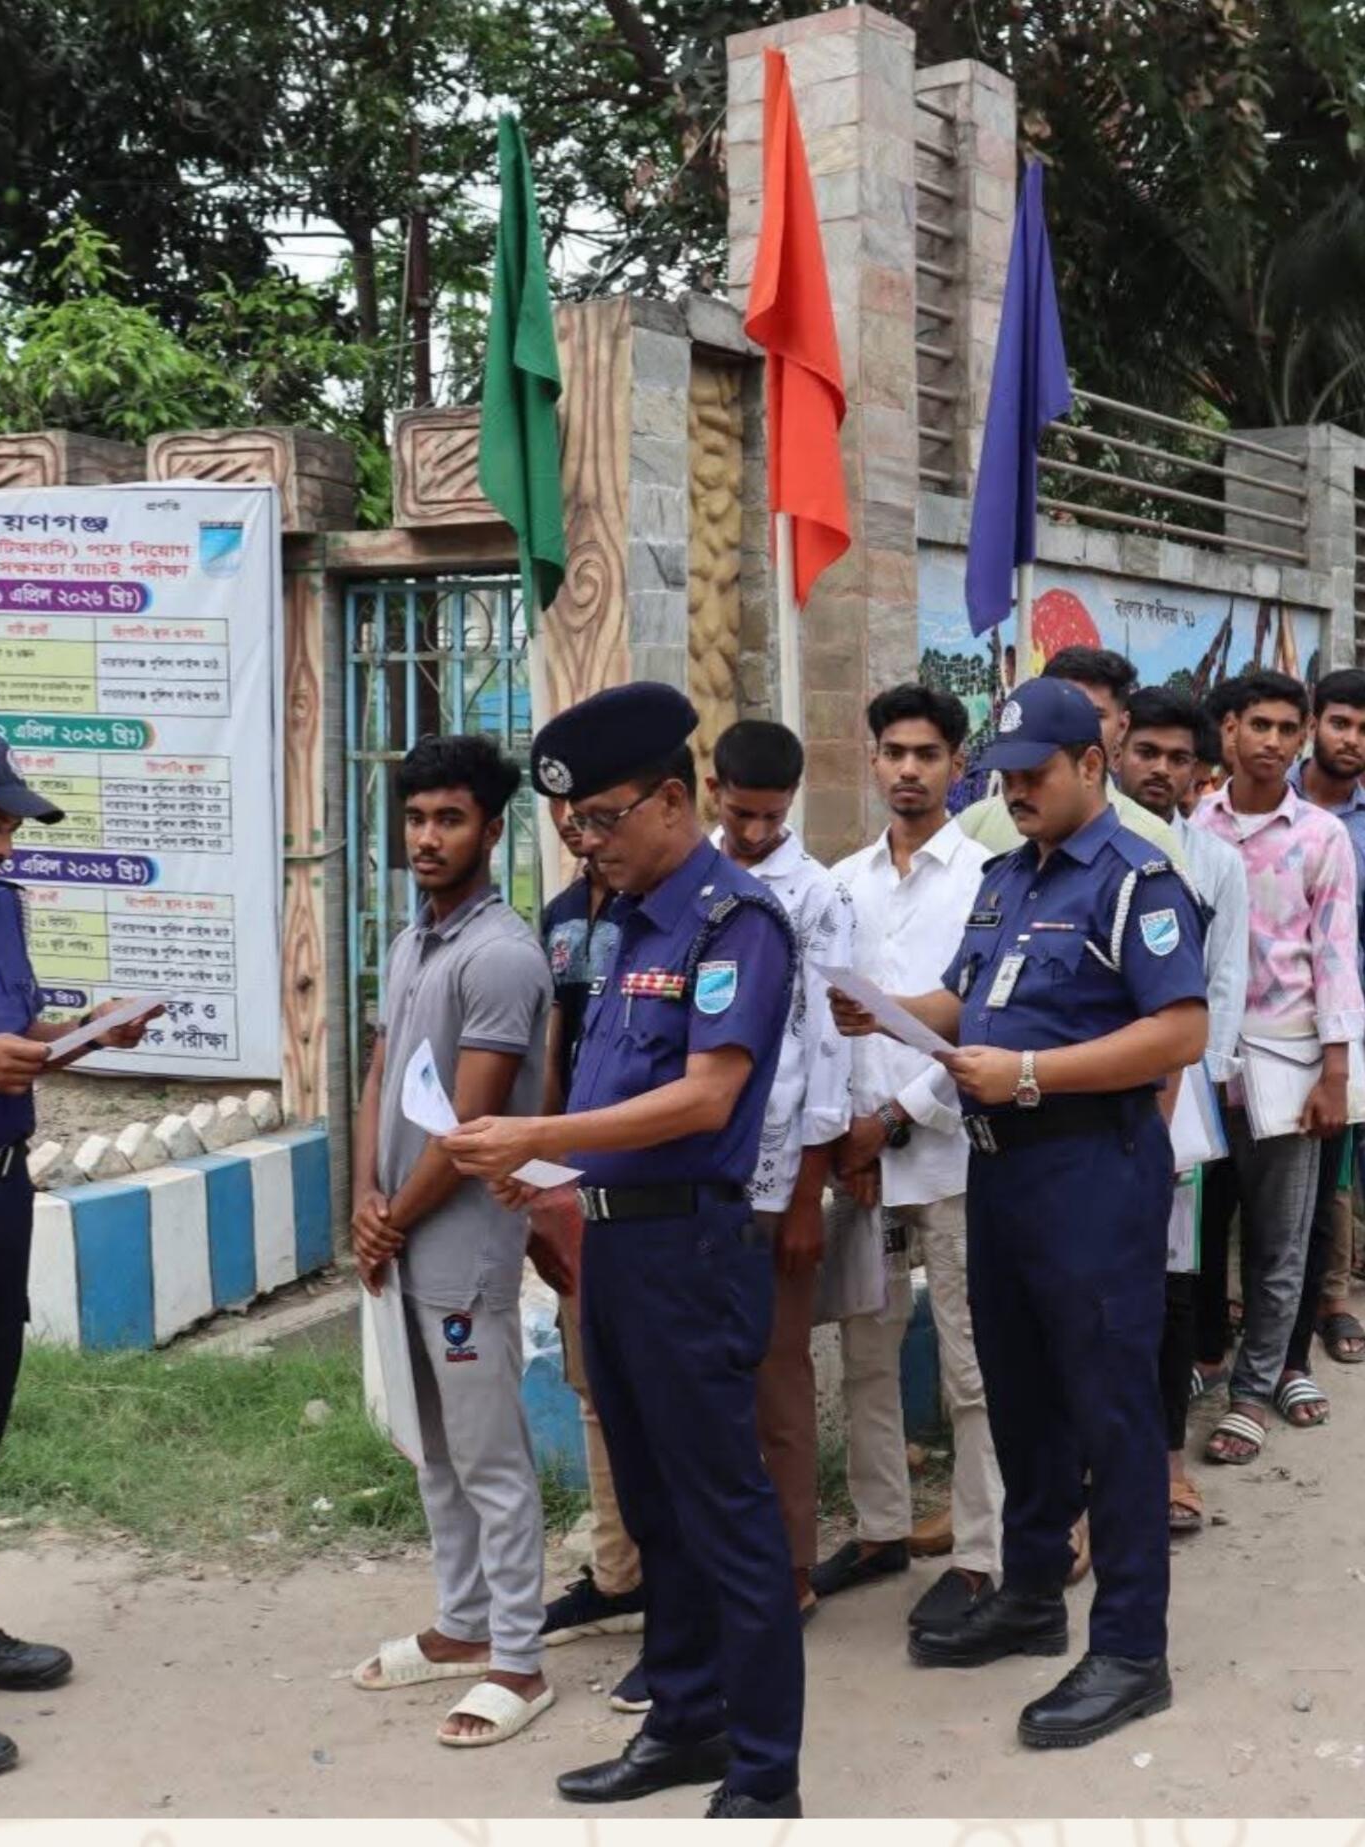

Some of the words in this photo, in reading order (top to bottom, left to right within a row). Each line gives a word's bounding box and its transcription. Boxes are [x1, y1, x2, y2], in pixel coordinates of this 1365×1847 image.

[57, 590, 104, 606] ২০২৬
[60, 727, 107, 743] ২০২৬
[67, 862, 113, 878] ২০২৬
[173, 1023, 228, 1051] পরীক্ষা
